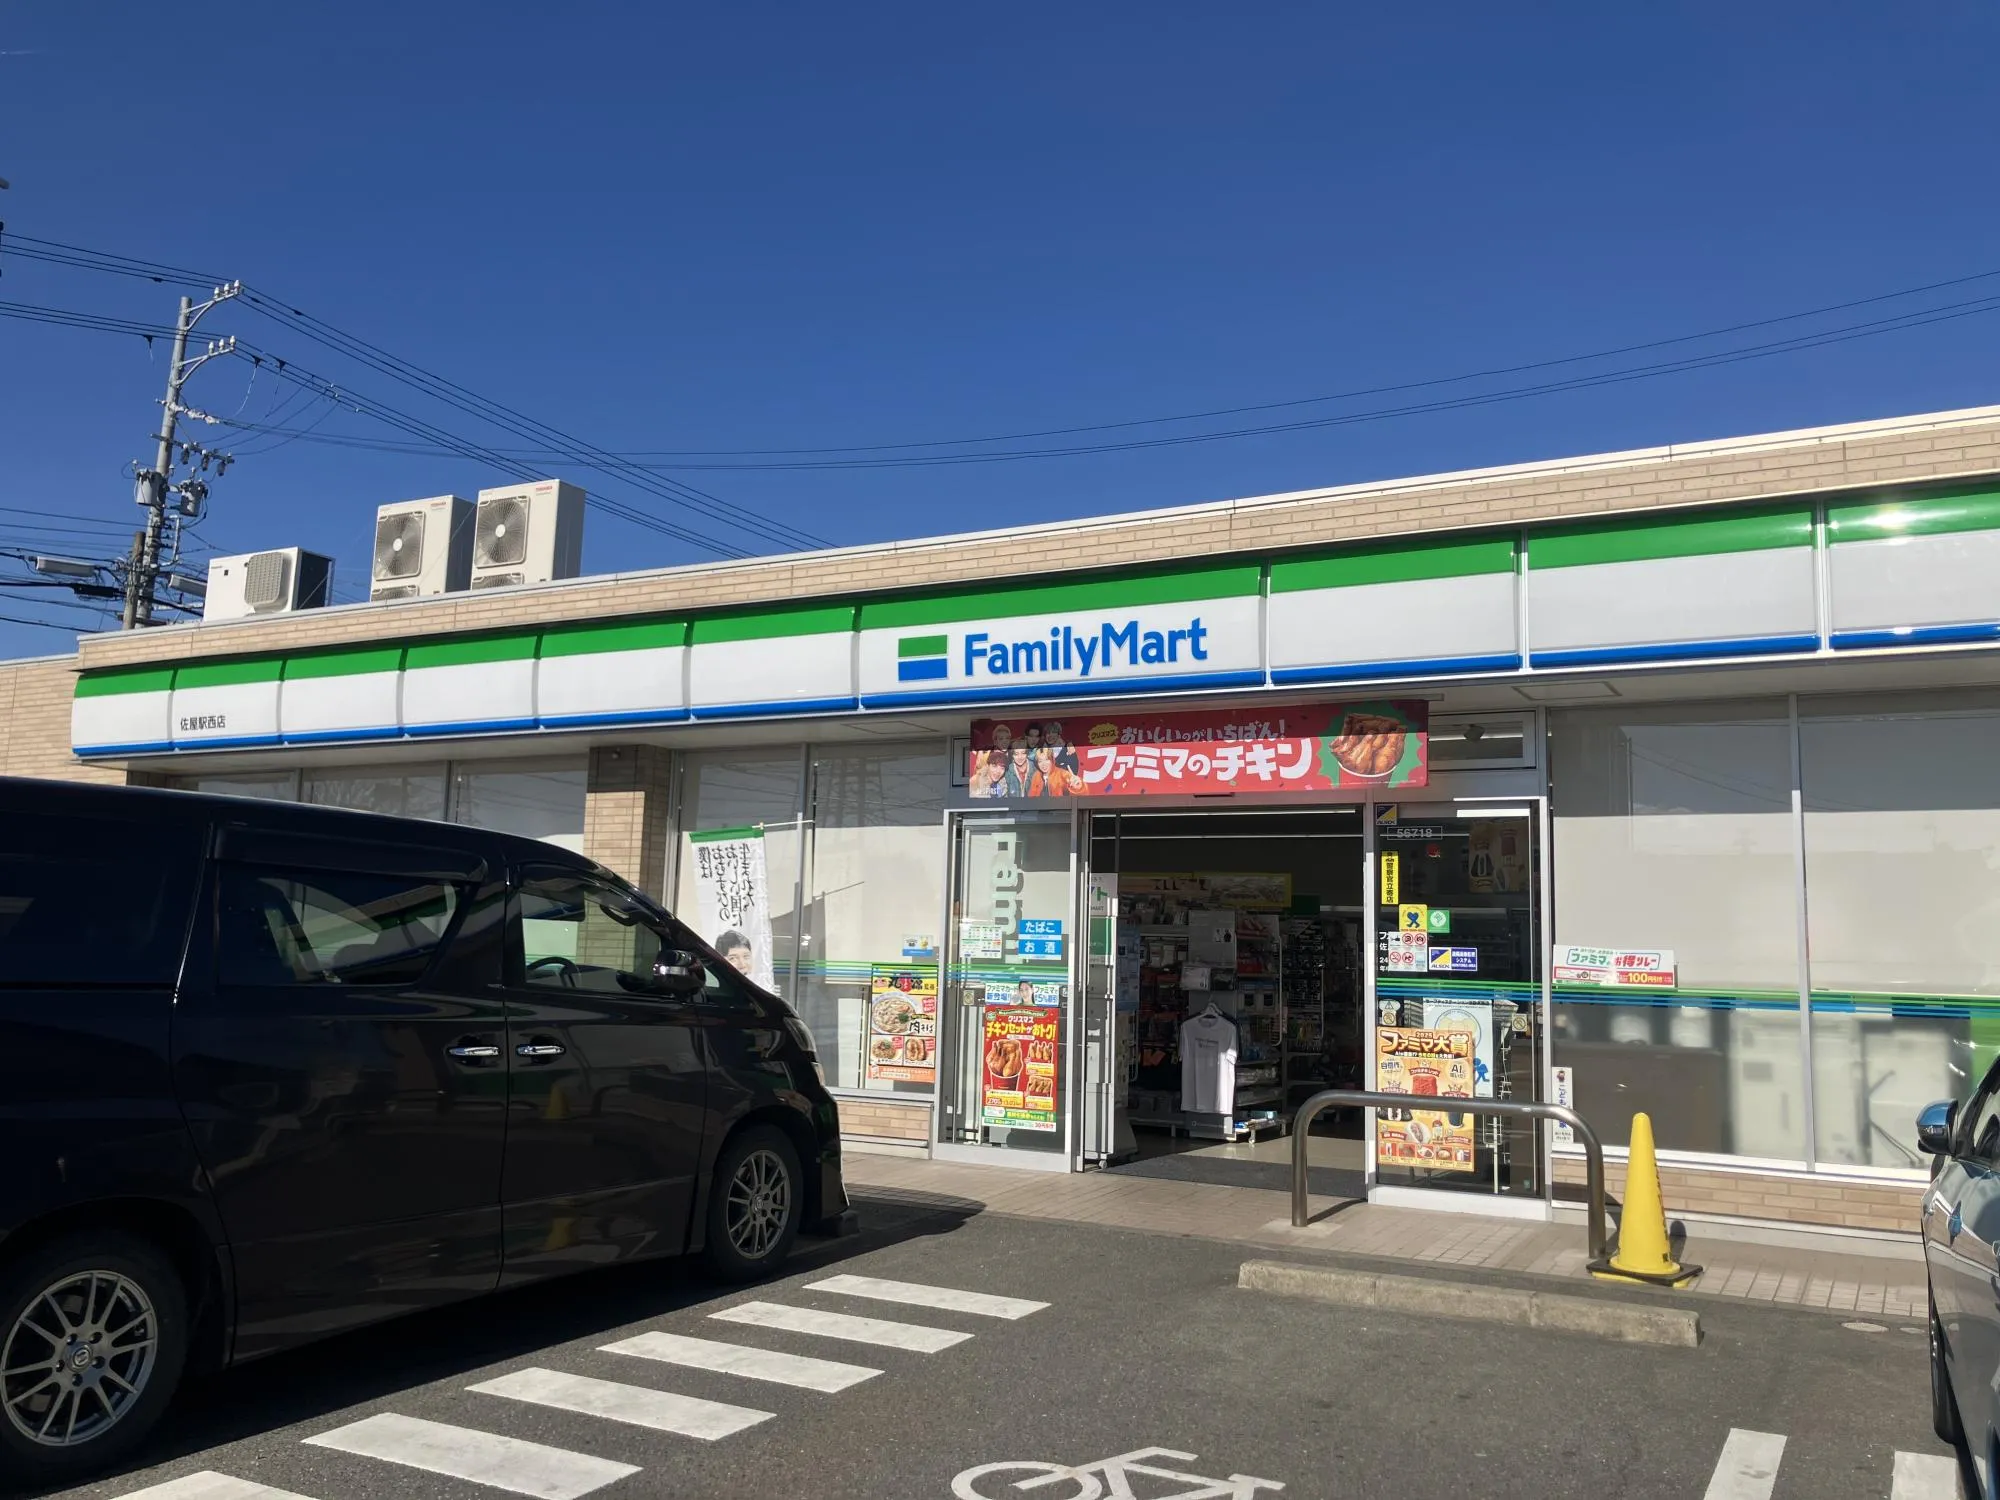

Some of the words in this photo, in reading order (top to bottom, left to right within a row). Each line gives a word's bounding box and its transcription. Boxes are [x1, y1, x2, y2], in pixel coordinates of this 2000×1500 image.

[965, 617, 1208, 676] FamilyMart
[180, 715, 226, 731] 佐屋駅西店
[1091, 729, 1116, 740] クリスマス
[1083, 737, 1313, 783] ファミマのチキン
[1396, 828, 1433, 839] 56718
[1025, 921, 1056, 933] たばこ
[1024, 942, 1056, 954] お酒
[1008, 1015, 1034, 1023] クリスマス
[1380, 1030, 1470, 1057] ファミマ大賞
